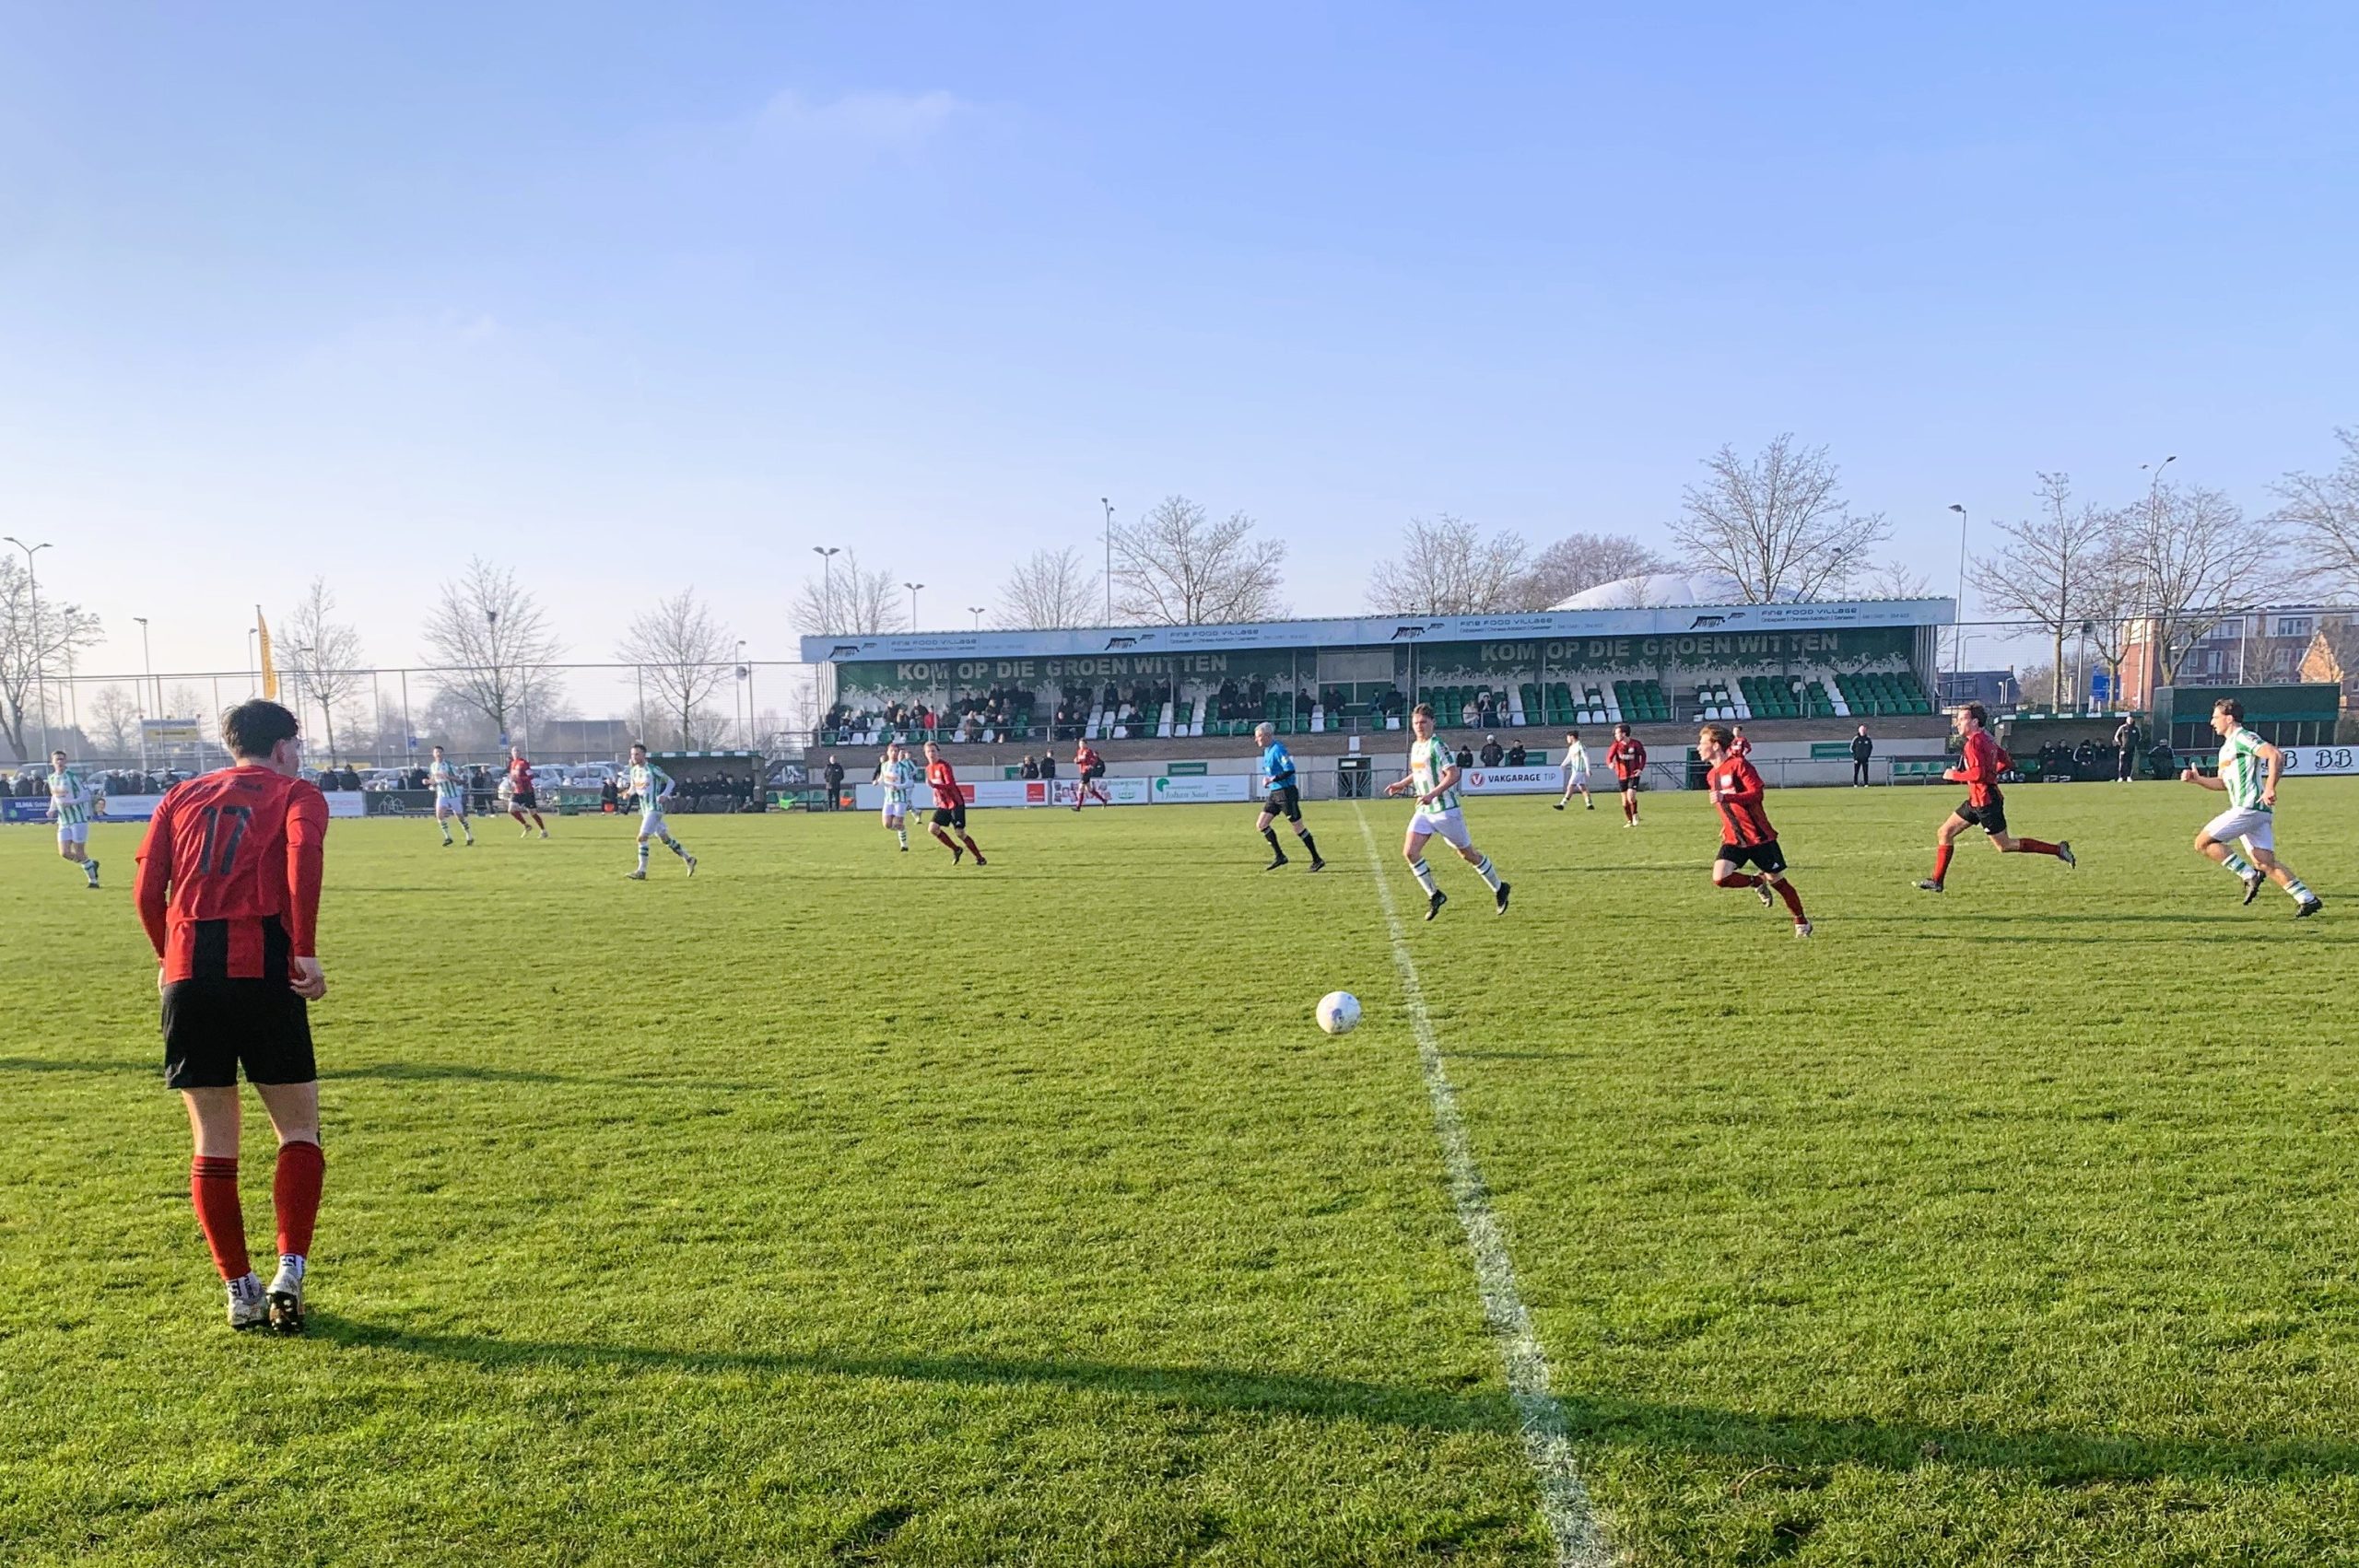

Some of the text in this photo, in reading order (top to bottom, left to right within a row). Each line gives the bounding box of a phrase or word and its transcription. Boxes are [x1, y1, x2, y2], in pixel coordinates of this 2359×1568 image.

[1481, 643, 1536, 661] KOM
[1546, 641, 1580, 660] OP
[1589, 639, 1630, 658] DIE
[1642, 637, 1731, 656] GROEN
[897, 662, 949, 681] KOM
[957, 661, 989, 680] OP
[996, 661, 1035, 679] DIE
[1046, 658, 1129, 677] GROEN
[1488, 773, 1541, 783] VAKGARAGE
[201, 805, 252, 874] 17
